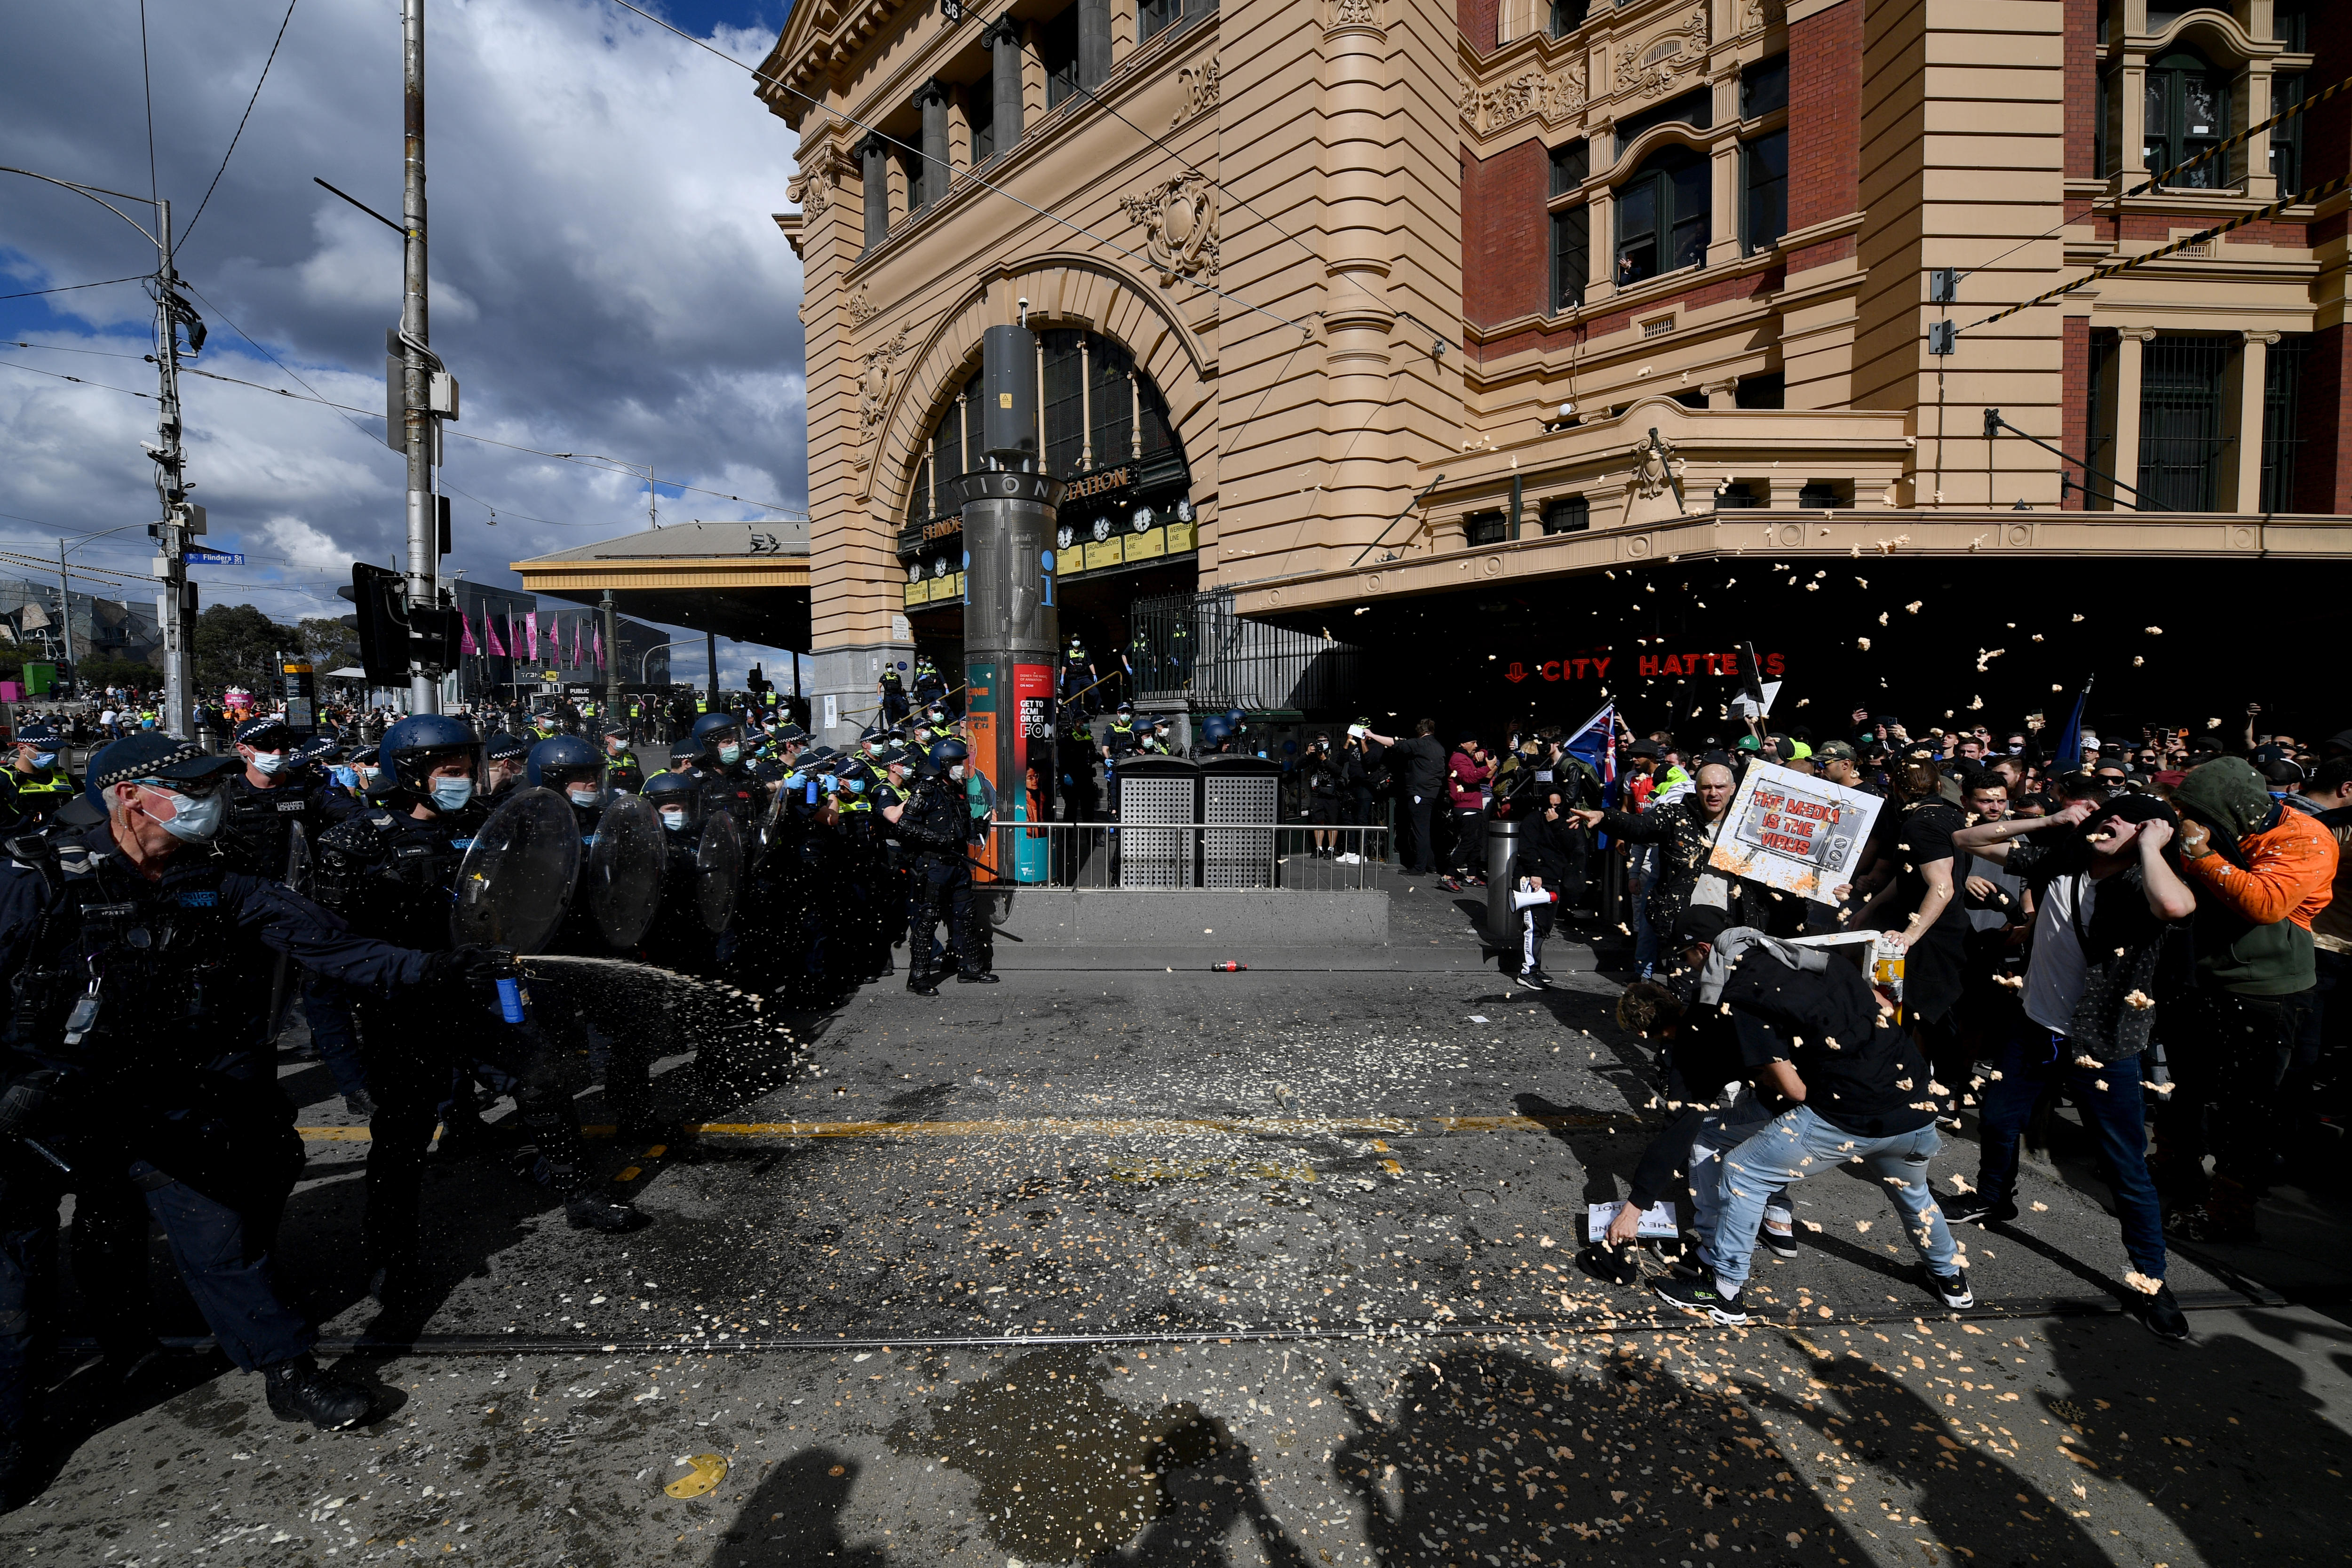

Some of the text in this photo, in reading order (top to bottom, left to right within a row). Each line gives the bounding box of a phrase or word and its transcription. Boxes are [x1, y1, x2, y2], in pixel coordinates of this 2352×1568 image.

[945, 0, 958, 19] 36
[1169, 523, 1192, 533] WERRIBEE
[1087, 539, 1119, 551] BROADMEADOWS
[1542, 657, 1611, 681] CITY
[1753, 790, 1840, 825] THE MEDIA
[1762, 812, 1815, 837] IS THE
[1761, 833, 1811, 855] VIRUS
[178, 892, 215, 901] Police
